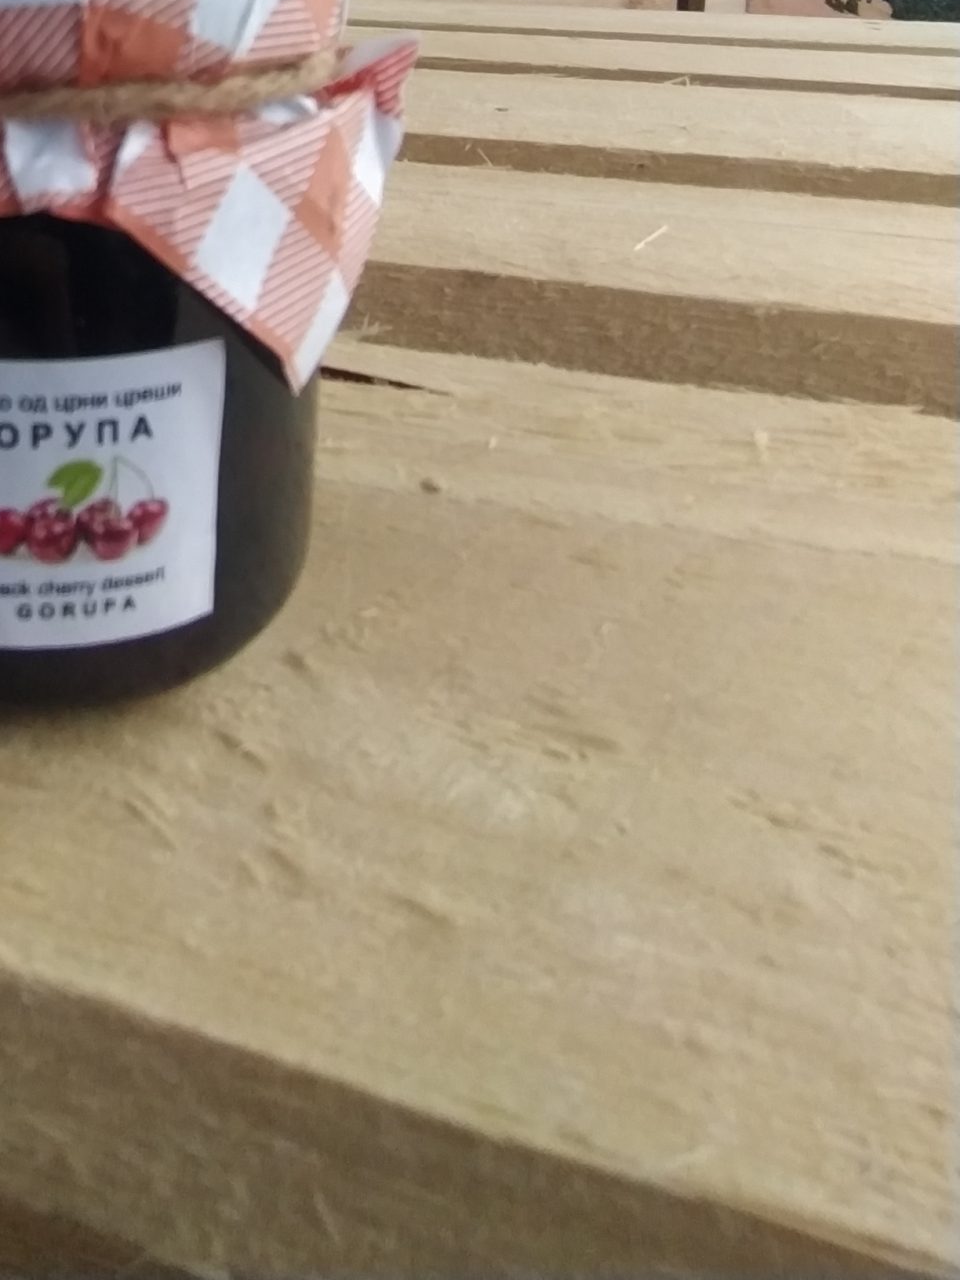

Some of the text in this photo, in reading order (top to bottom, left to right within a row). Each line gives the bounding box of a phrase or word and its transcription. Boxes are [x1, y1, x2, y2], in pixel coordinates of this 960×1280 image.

[17, 394, 49, 414] од
[37, 579, 97, 597] cherry
[101, 565, 166, 593] dessert
[14, 595, 137, 623] GORUPA
